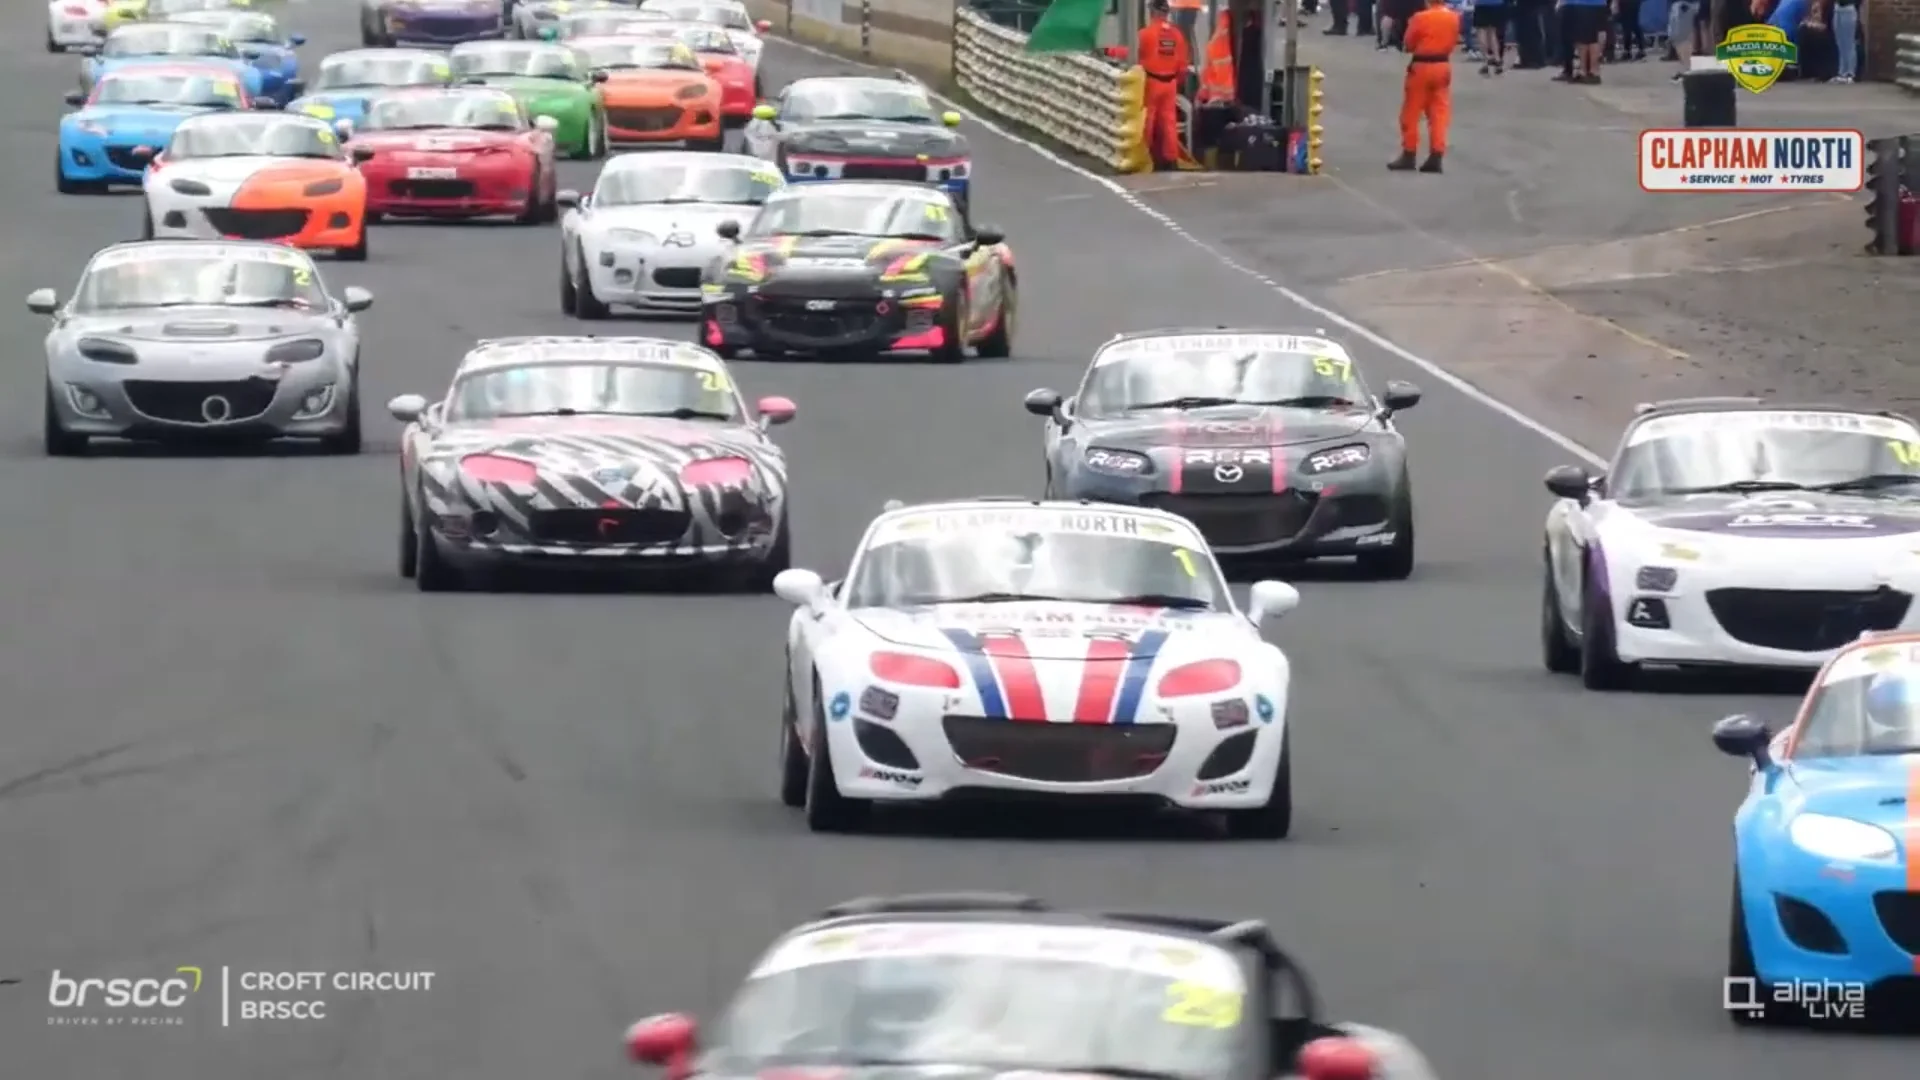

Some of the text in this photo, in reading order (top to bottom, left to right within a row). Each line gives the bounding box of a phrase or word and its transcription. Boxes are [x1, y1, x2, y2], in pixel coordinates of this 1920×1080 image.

[1313, 357, 1350, 382] 57
[1060, 515, 1138, 534] NORTH
[1171, 548, 1196, 578] 1
